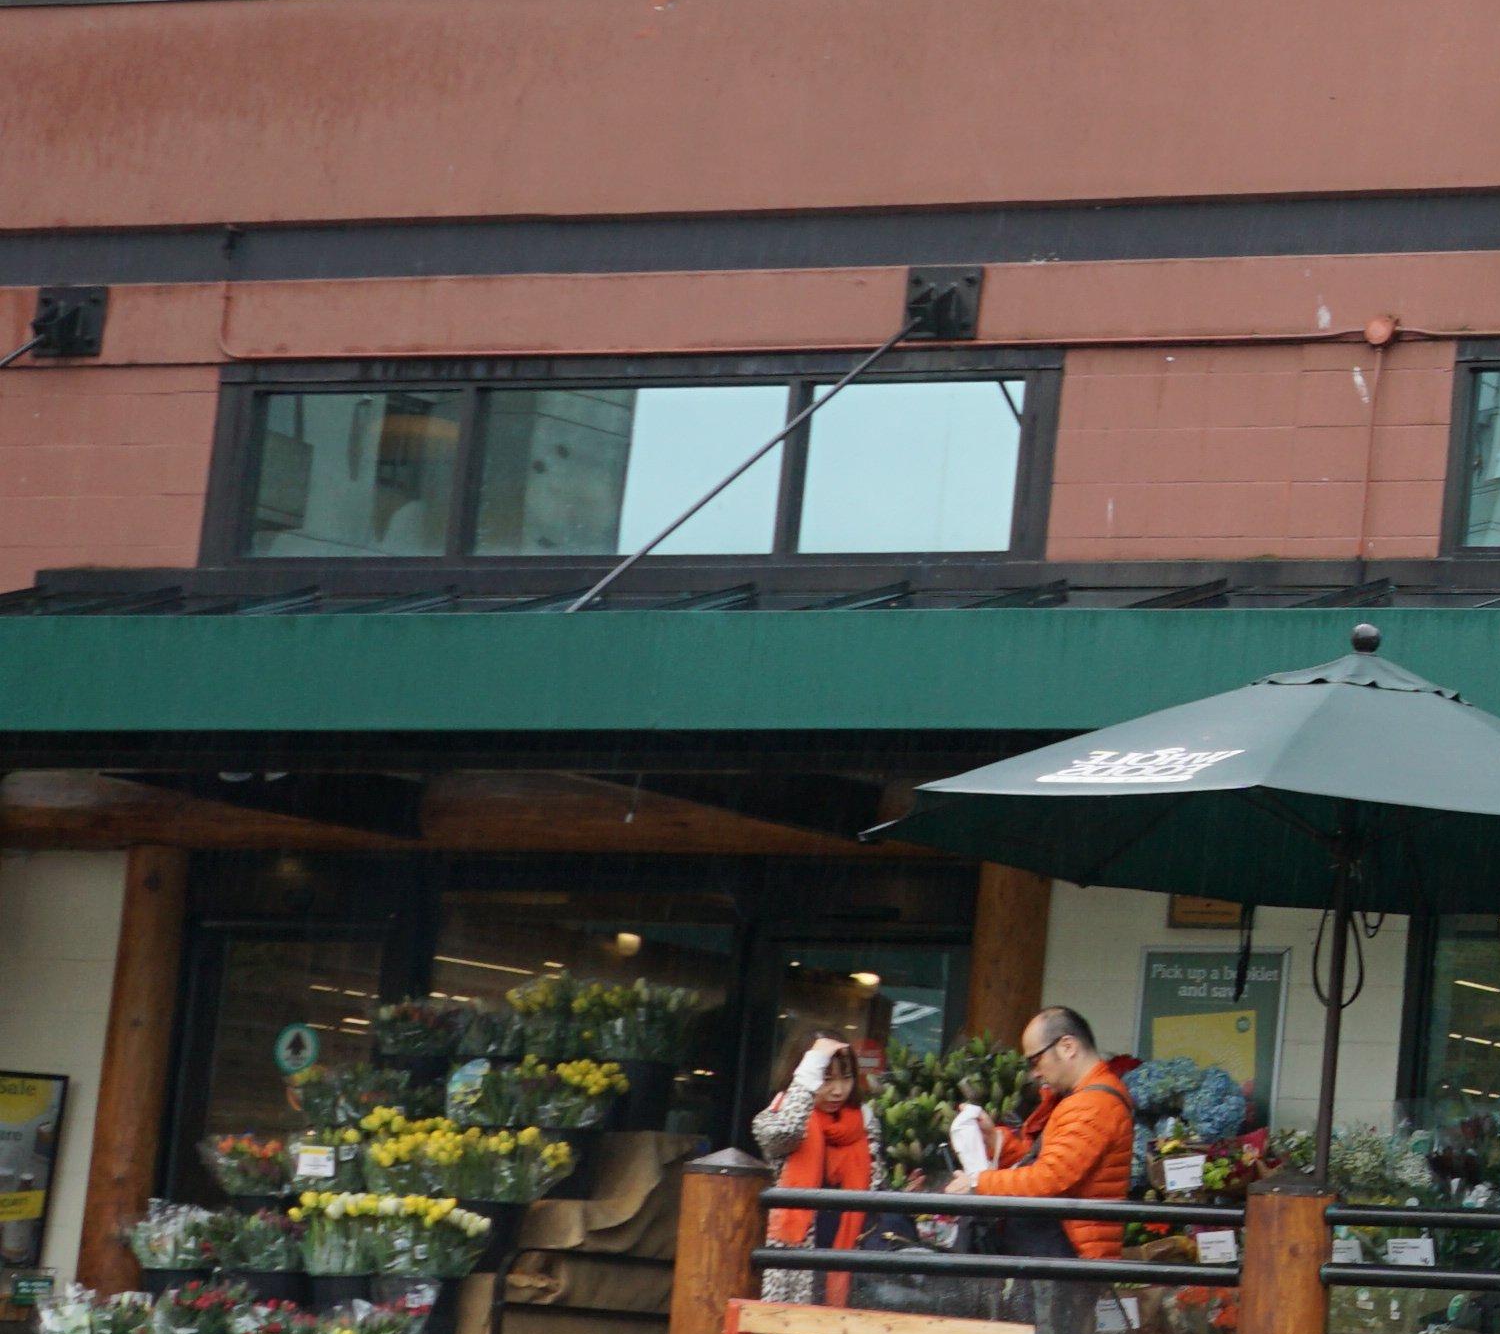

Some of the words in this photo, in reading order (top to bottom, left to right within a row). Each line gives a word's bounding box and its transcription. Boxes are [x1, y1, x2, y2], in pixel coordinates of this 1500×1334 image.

[1151, 963, 1183, 979] Pick
[1187, 968, 1206, 983] up
[1210, 969, 1219, 980] a
[1178, 983, 1208, 998] and
